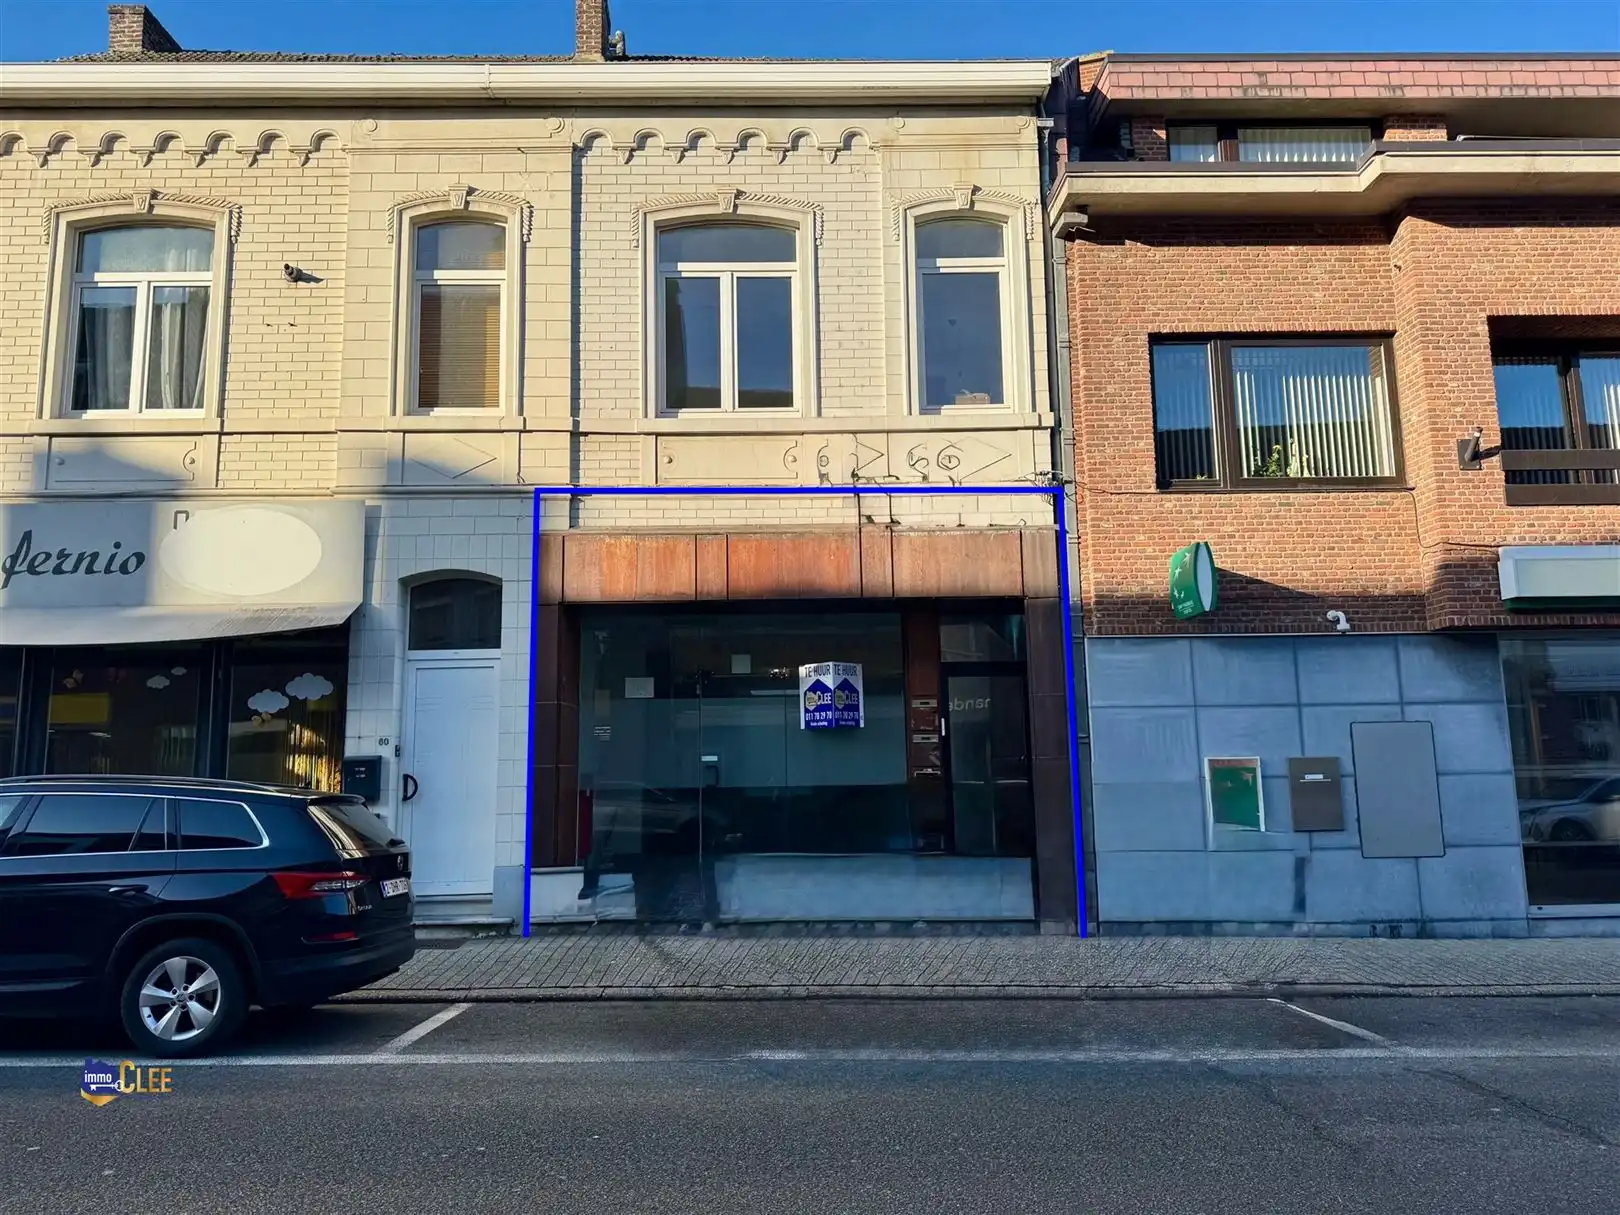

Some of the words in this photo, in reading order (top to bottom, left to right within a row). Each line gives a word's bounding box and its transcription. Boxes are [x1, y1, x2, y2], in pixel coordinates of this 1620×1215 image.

[805, 667, 812, 678] TE
[813, 664, 831, 677] HUUR
[833, 664, 841, 676] TE
